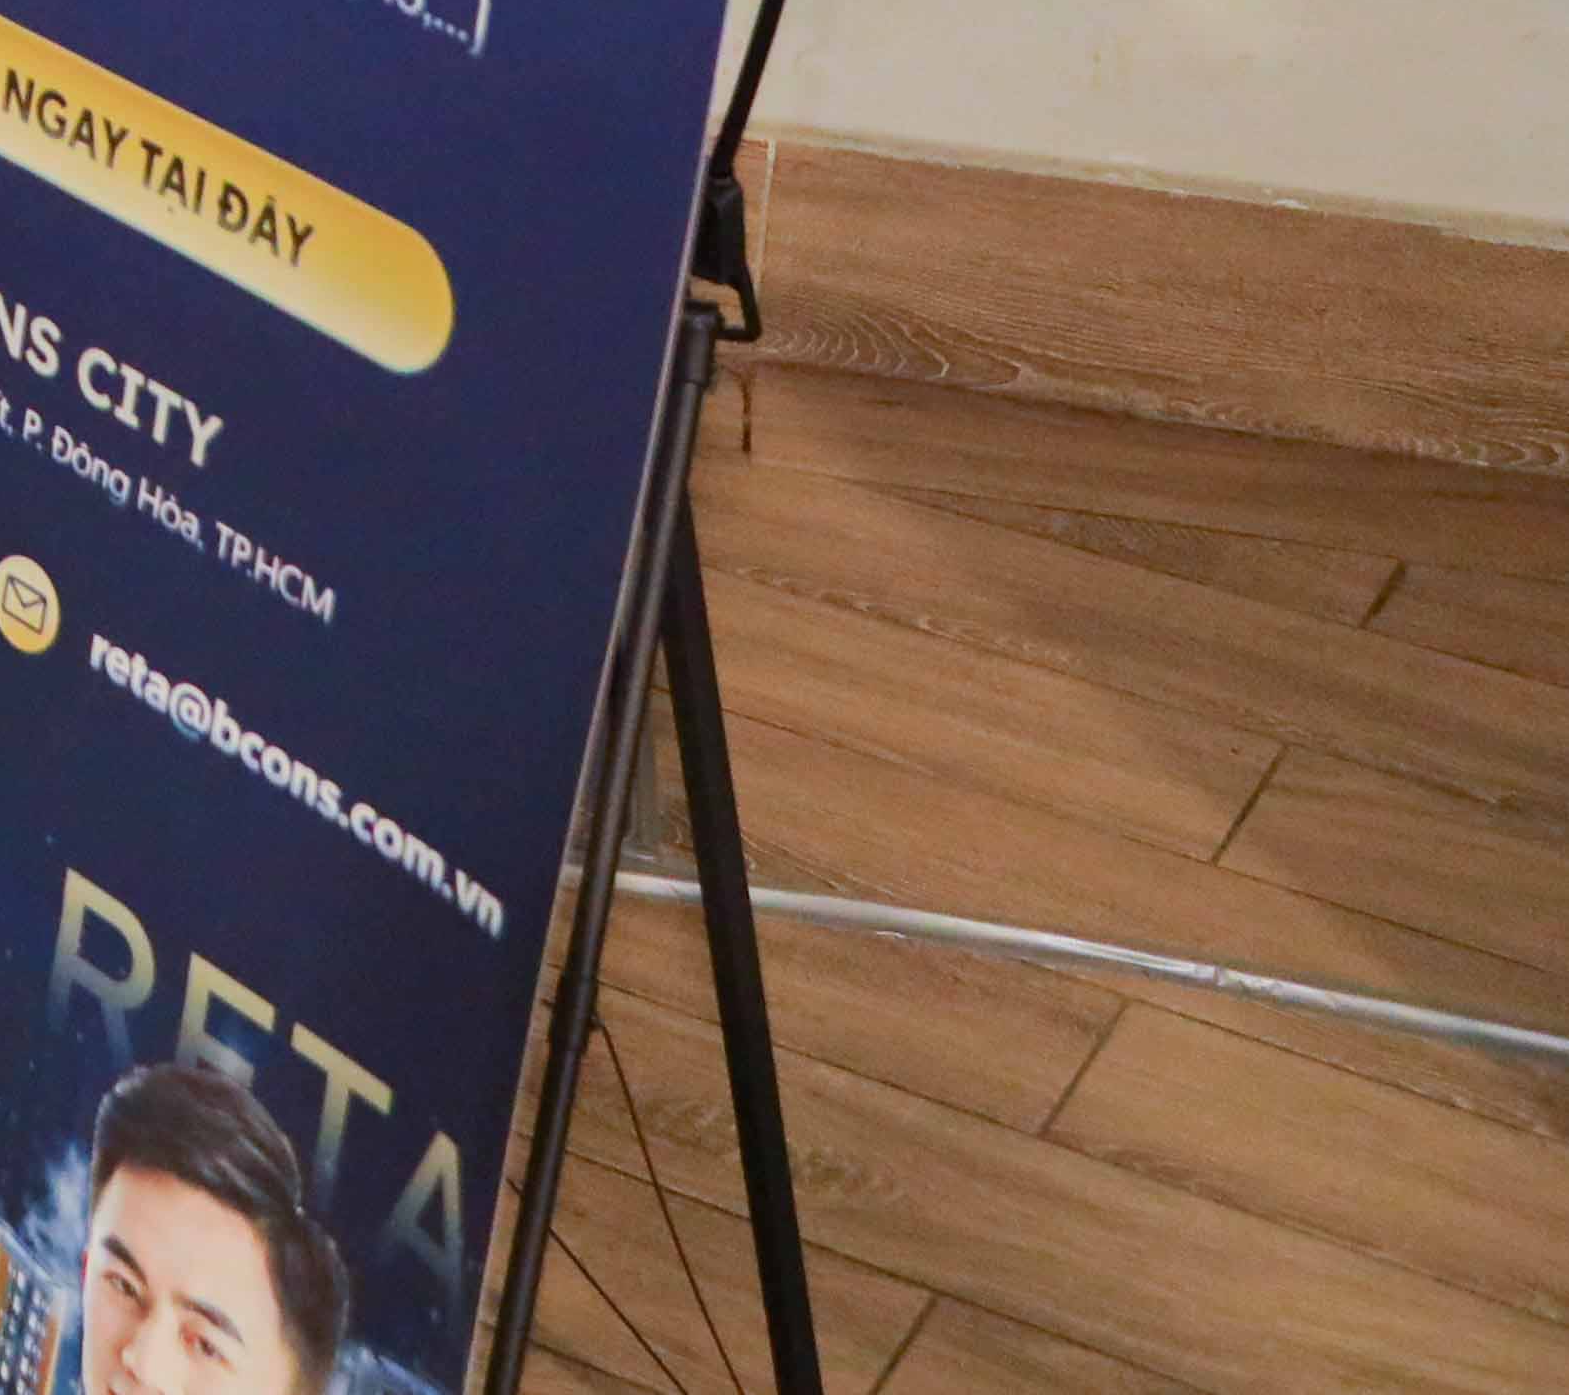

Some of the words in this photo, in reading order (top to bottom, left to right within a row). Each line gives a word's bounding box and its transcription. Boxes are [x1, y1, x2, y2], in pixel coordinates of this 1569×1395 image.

[2, 68, 129, 169] NGAY
[140, 139, 207, 217] TẠI
[217, 181, 313, 267] ĐÂY
[77, 346, 223, 467] CITY
[22, 409, 43, 451] P.
[51, 426, 132, 506] Đông
[137, 479, 204, 551] Hòa,
[216, 521, 337, 623] TP.HCM
[89, 626, 506, 941] reta@bcons.com.vn
[50, 868, 467, 1300] RETA
